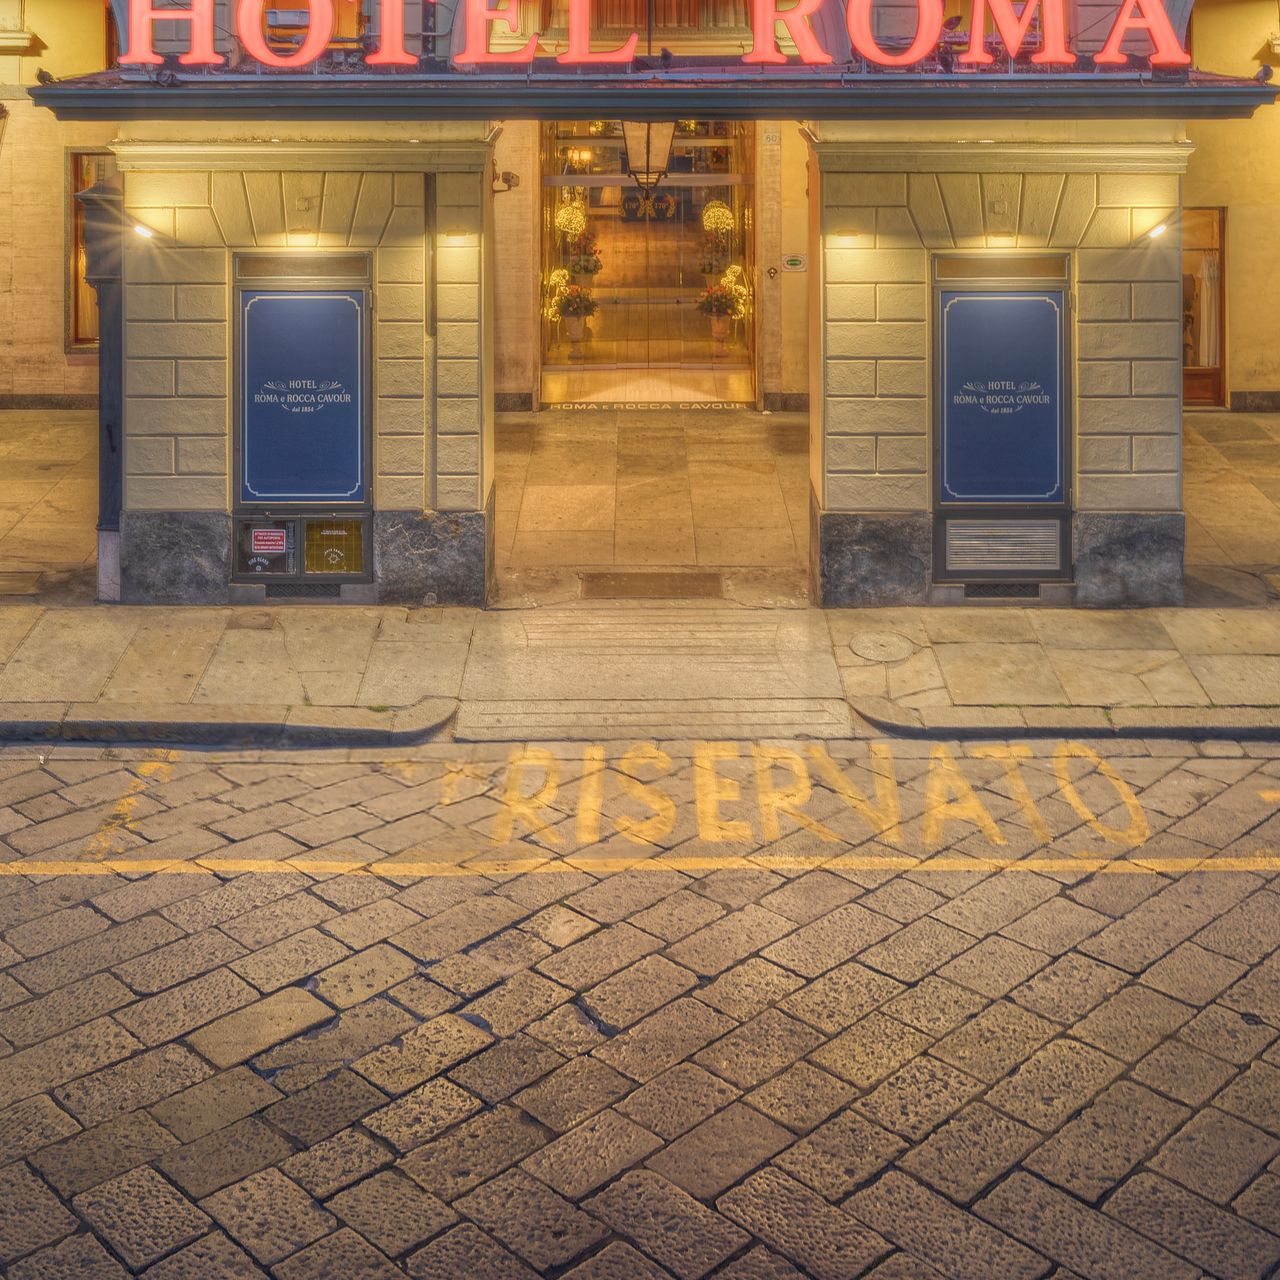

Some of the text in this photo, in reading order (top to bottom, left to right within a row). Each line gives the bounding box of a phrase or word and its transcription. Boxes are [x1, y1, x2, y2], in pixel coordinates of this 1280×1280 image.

[289, 380, 317, 389] HOTEL
[988, 381, 1016, 390] HOTEL
[254, 394, 279, 403] ROMA
[287, 394, 316, 403] ROCCA
[317, 394, 351, 403] CAVOUR
[953, 395, 978, 404] ROMA
[986, 395, 1015, 404] ROCCA
[1016, 395, 1050, 404] CAVOUR
[489, 741, 1150, 847] RISERVATO
